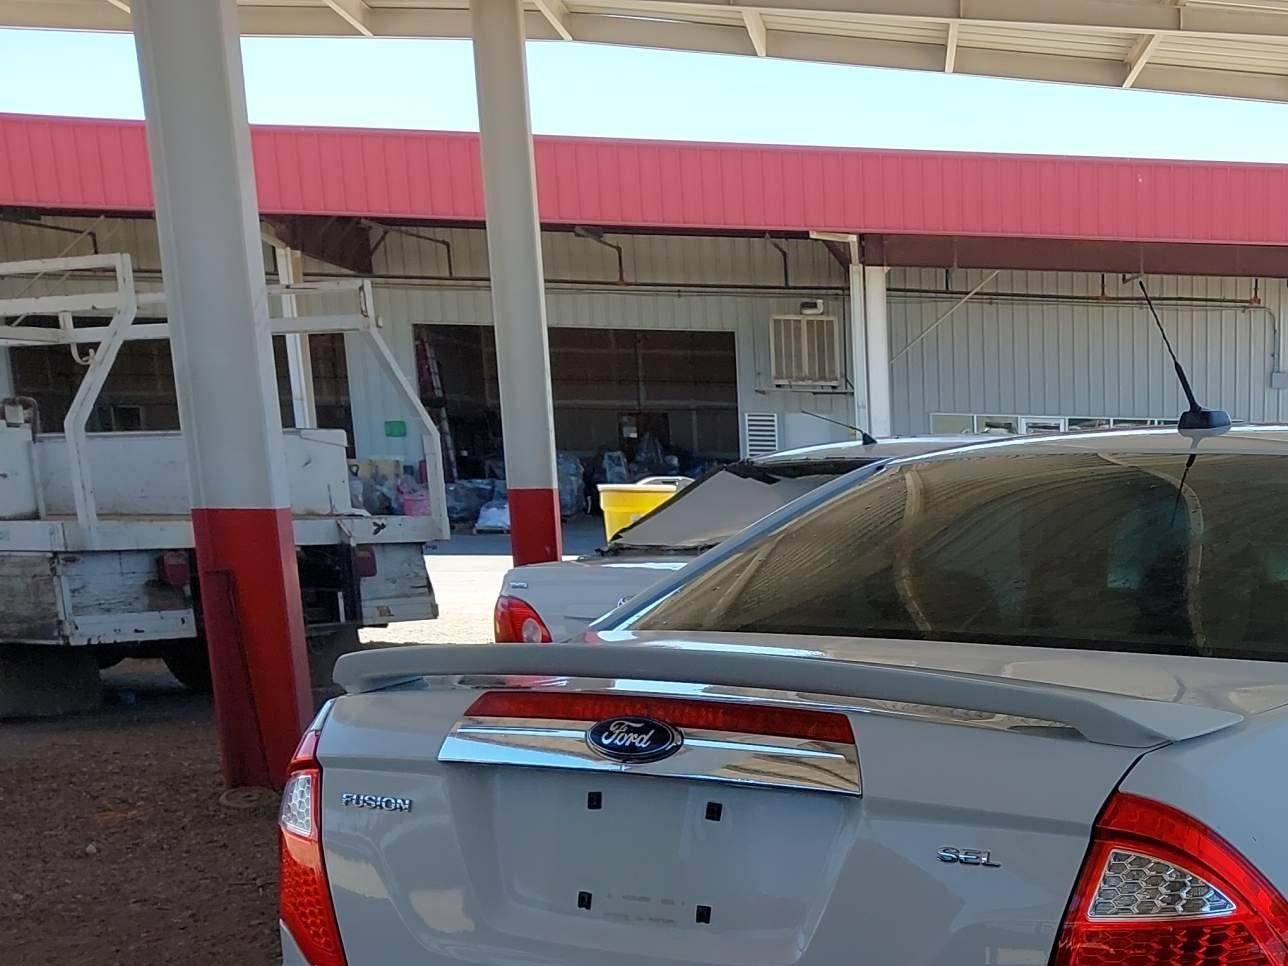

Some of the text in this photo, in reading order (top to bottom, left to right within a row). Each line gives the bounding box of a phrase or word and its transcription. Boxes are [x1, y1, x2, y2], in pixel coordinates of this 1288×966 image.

[601, 720, 656, 748] Ford
[341, 793, 412, 813] FUSION
[936, 846, 1001, 868] SEL
